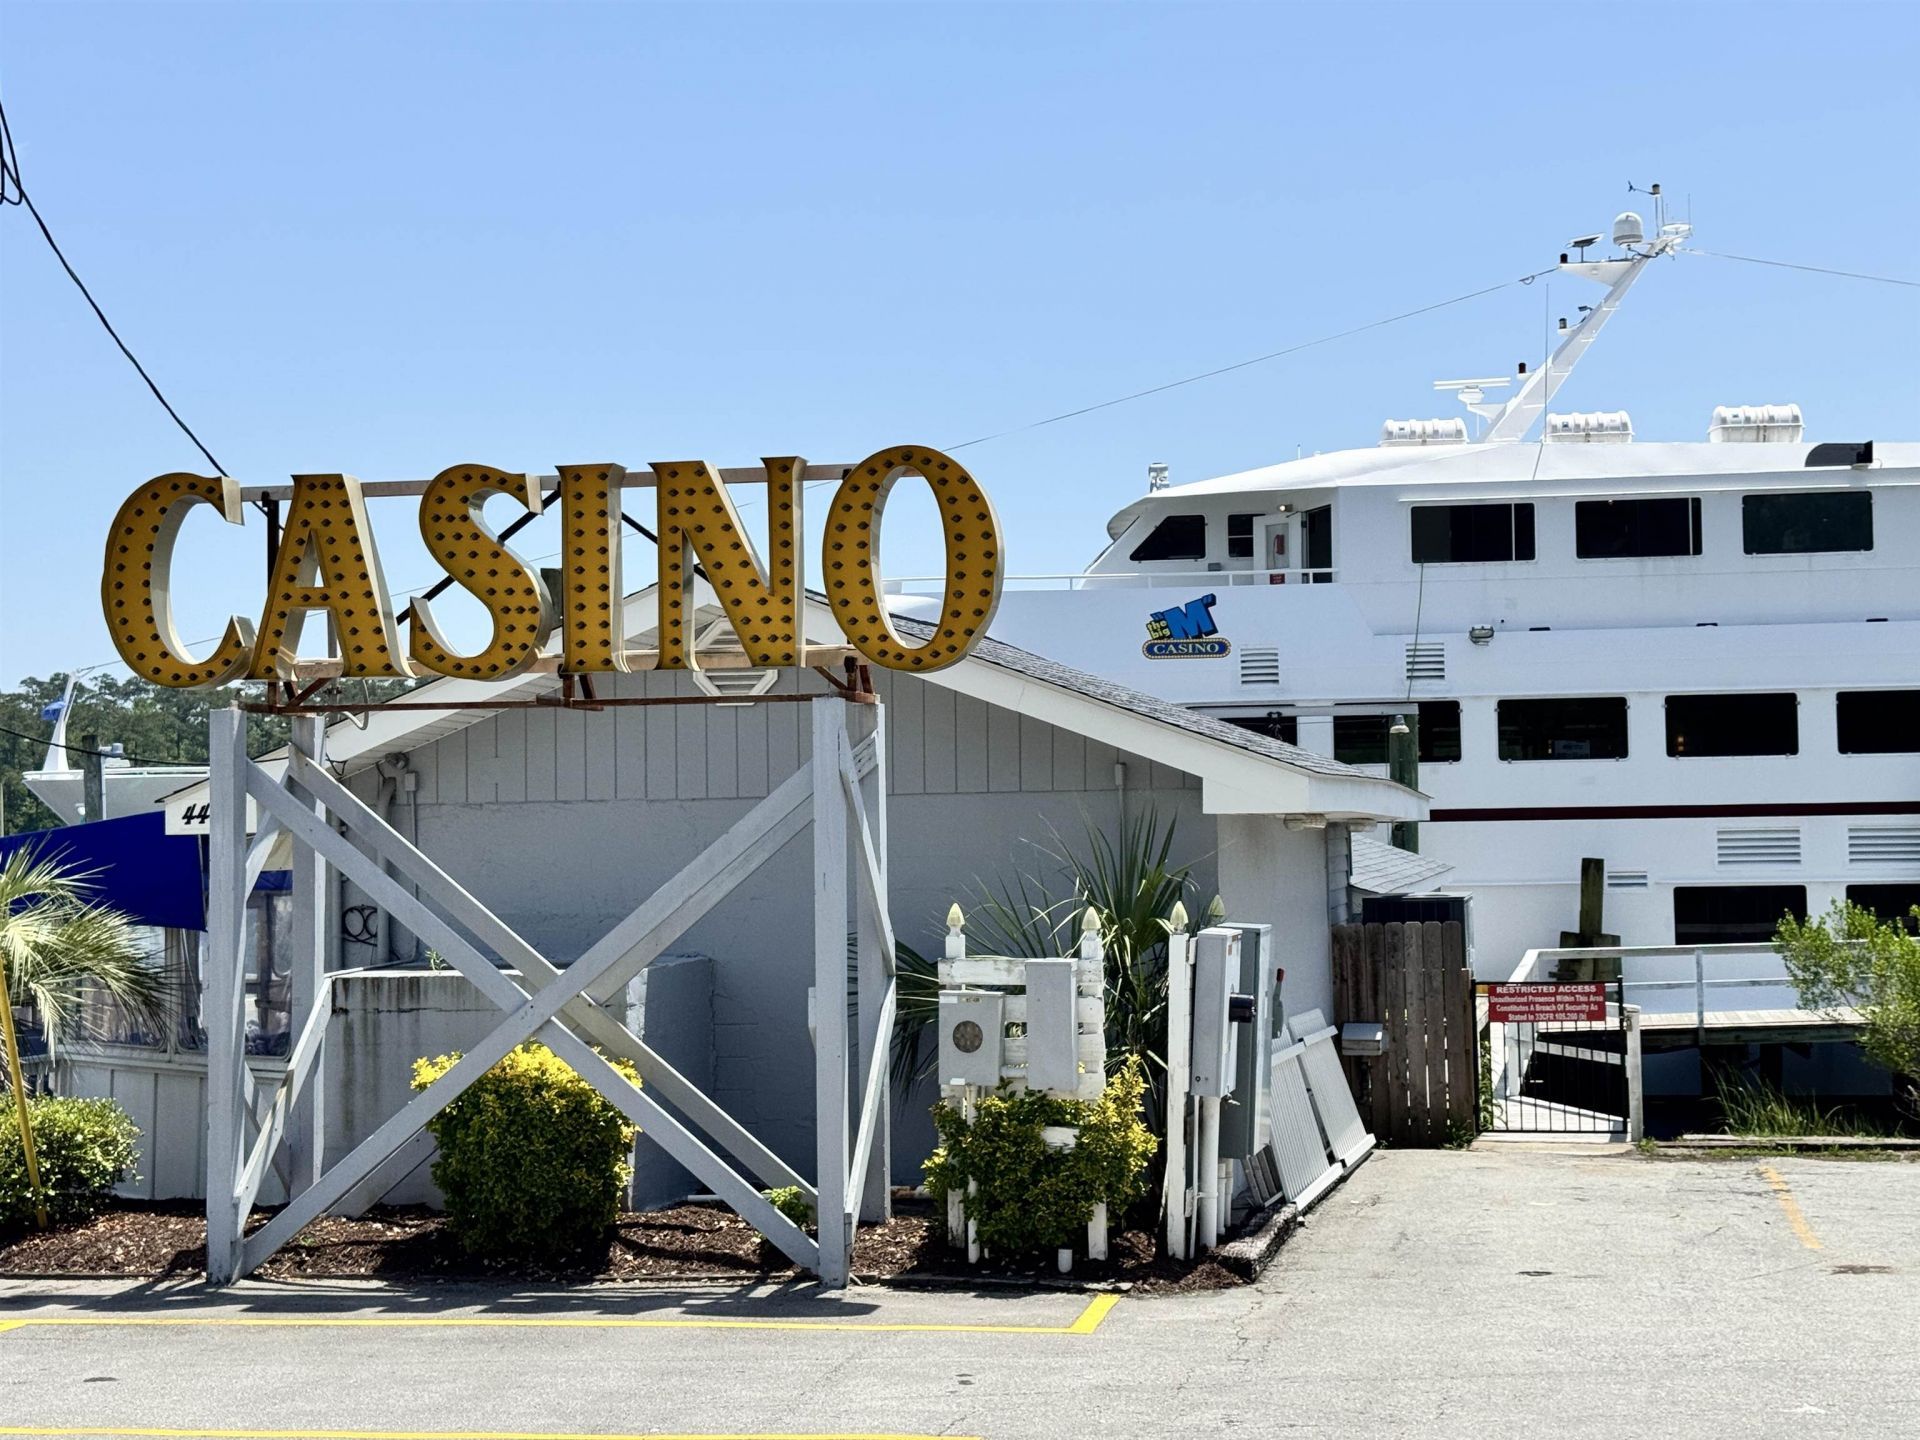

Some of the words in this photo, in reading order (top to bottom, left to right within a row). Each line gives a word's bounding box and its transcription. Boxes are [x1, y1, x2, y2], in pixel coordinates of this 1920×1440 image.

[101, 445, 1006, 688] CASINO
[1147, 620, 1168, 631] the
[1150, 628, 1171, 640] big
[1153, 643, 1219, 655] CASINO
[1558, 985, 1597, 993] ACCESS
[1565, 1004, 1589, 1013] Security
